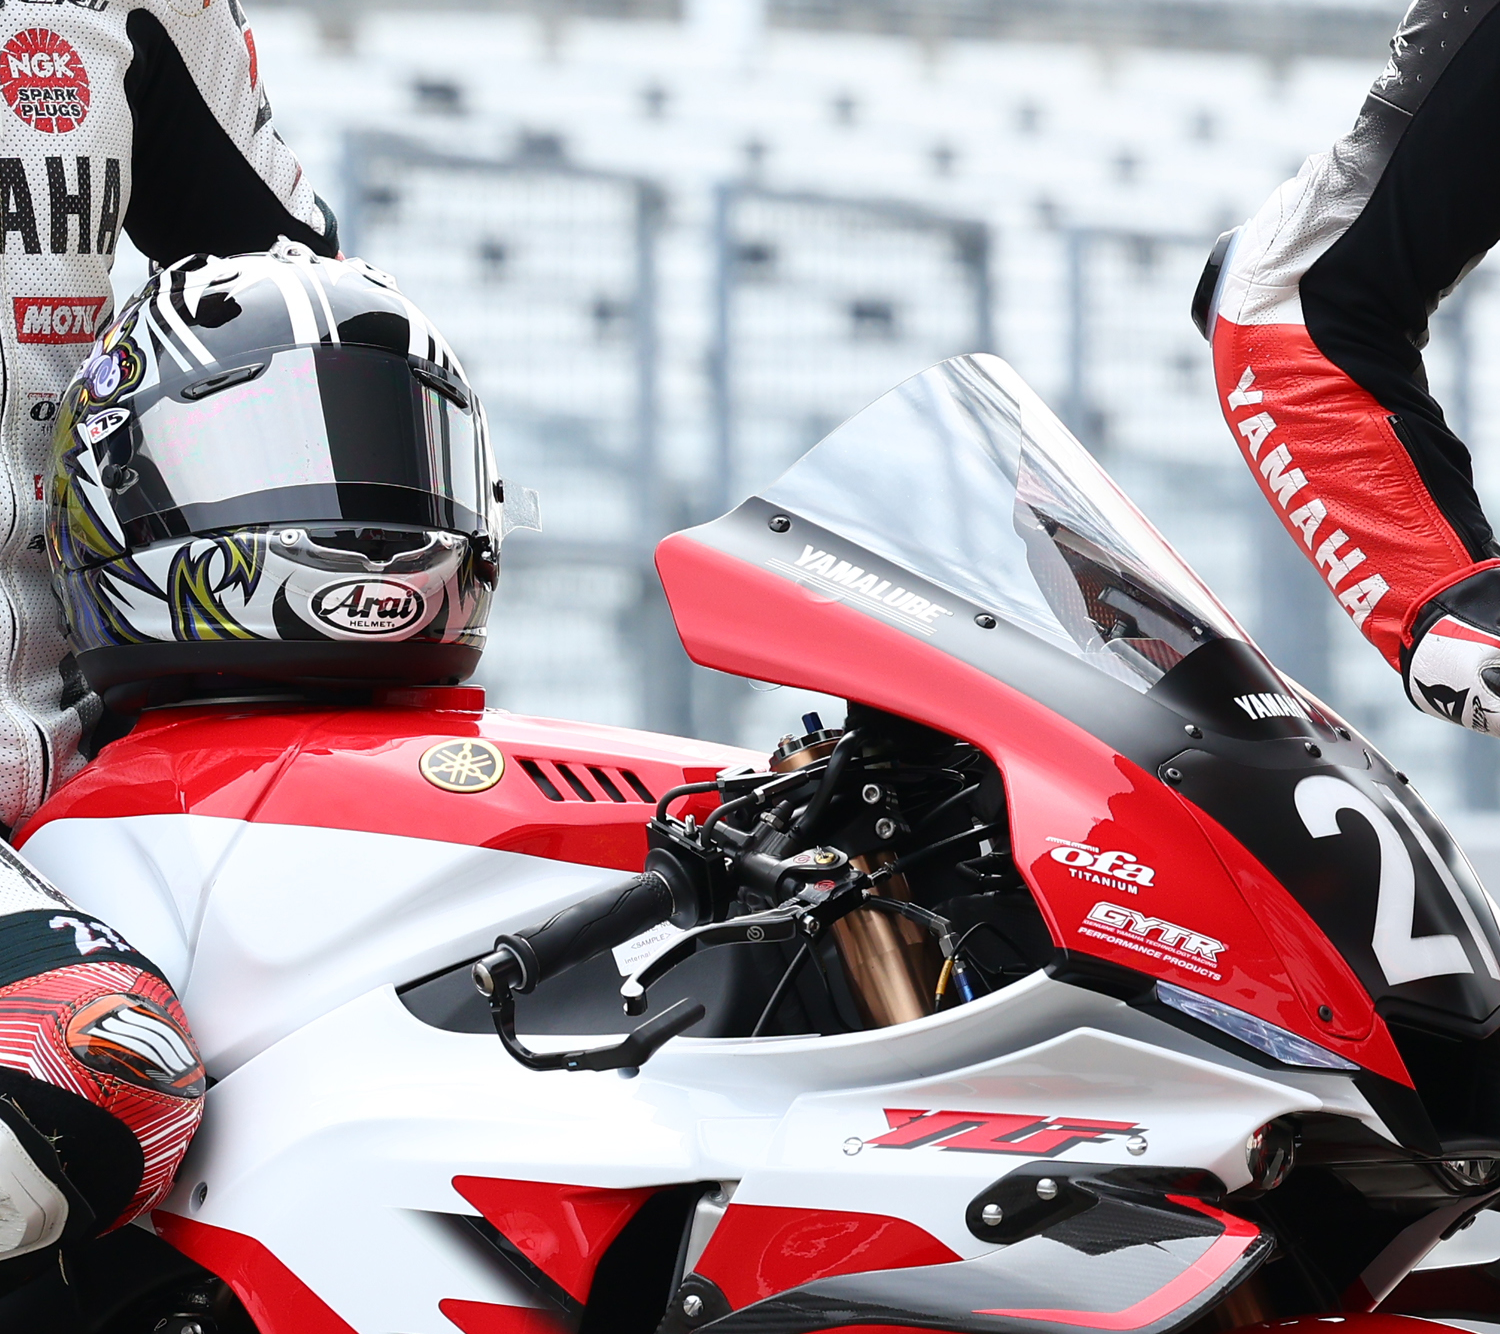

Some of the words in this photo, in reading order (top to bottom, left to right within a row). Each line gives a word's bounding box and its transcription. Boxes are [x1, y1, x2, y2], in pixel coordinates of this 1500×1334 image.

[5, 52, 76, 79] NGK
[18, 86, 79, 103] SPARK
[21, 103, 82, 119] PLUGS
[1226, 367, 1392, 631] YAMAHA
[318, 581, 414, 618] Arai
[792, 543, 951, 626] YAMALUBE
[349, 619, 392, 629] HELMET
[1050, 845, 1156, 888] ofa
[1068, 867, 1139, 895] TITANIUM
[1082, 919, 1117, 934] GENUINE
[1115, 929, 1145, 943] YAMAHA
[1145, 937, 1192, 959] TECHNOLOGY
[1191, 954, 1218, 969] RACING
[1086, 900, 1228, 964] GYTR
[1077, 926, 1162, 959] PERFORMANCE
[1162, 953, 1222, 982] PRODUCTS
